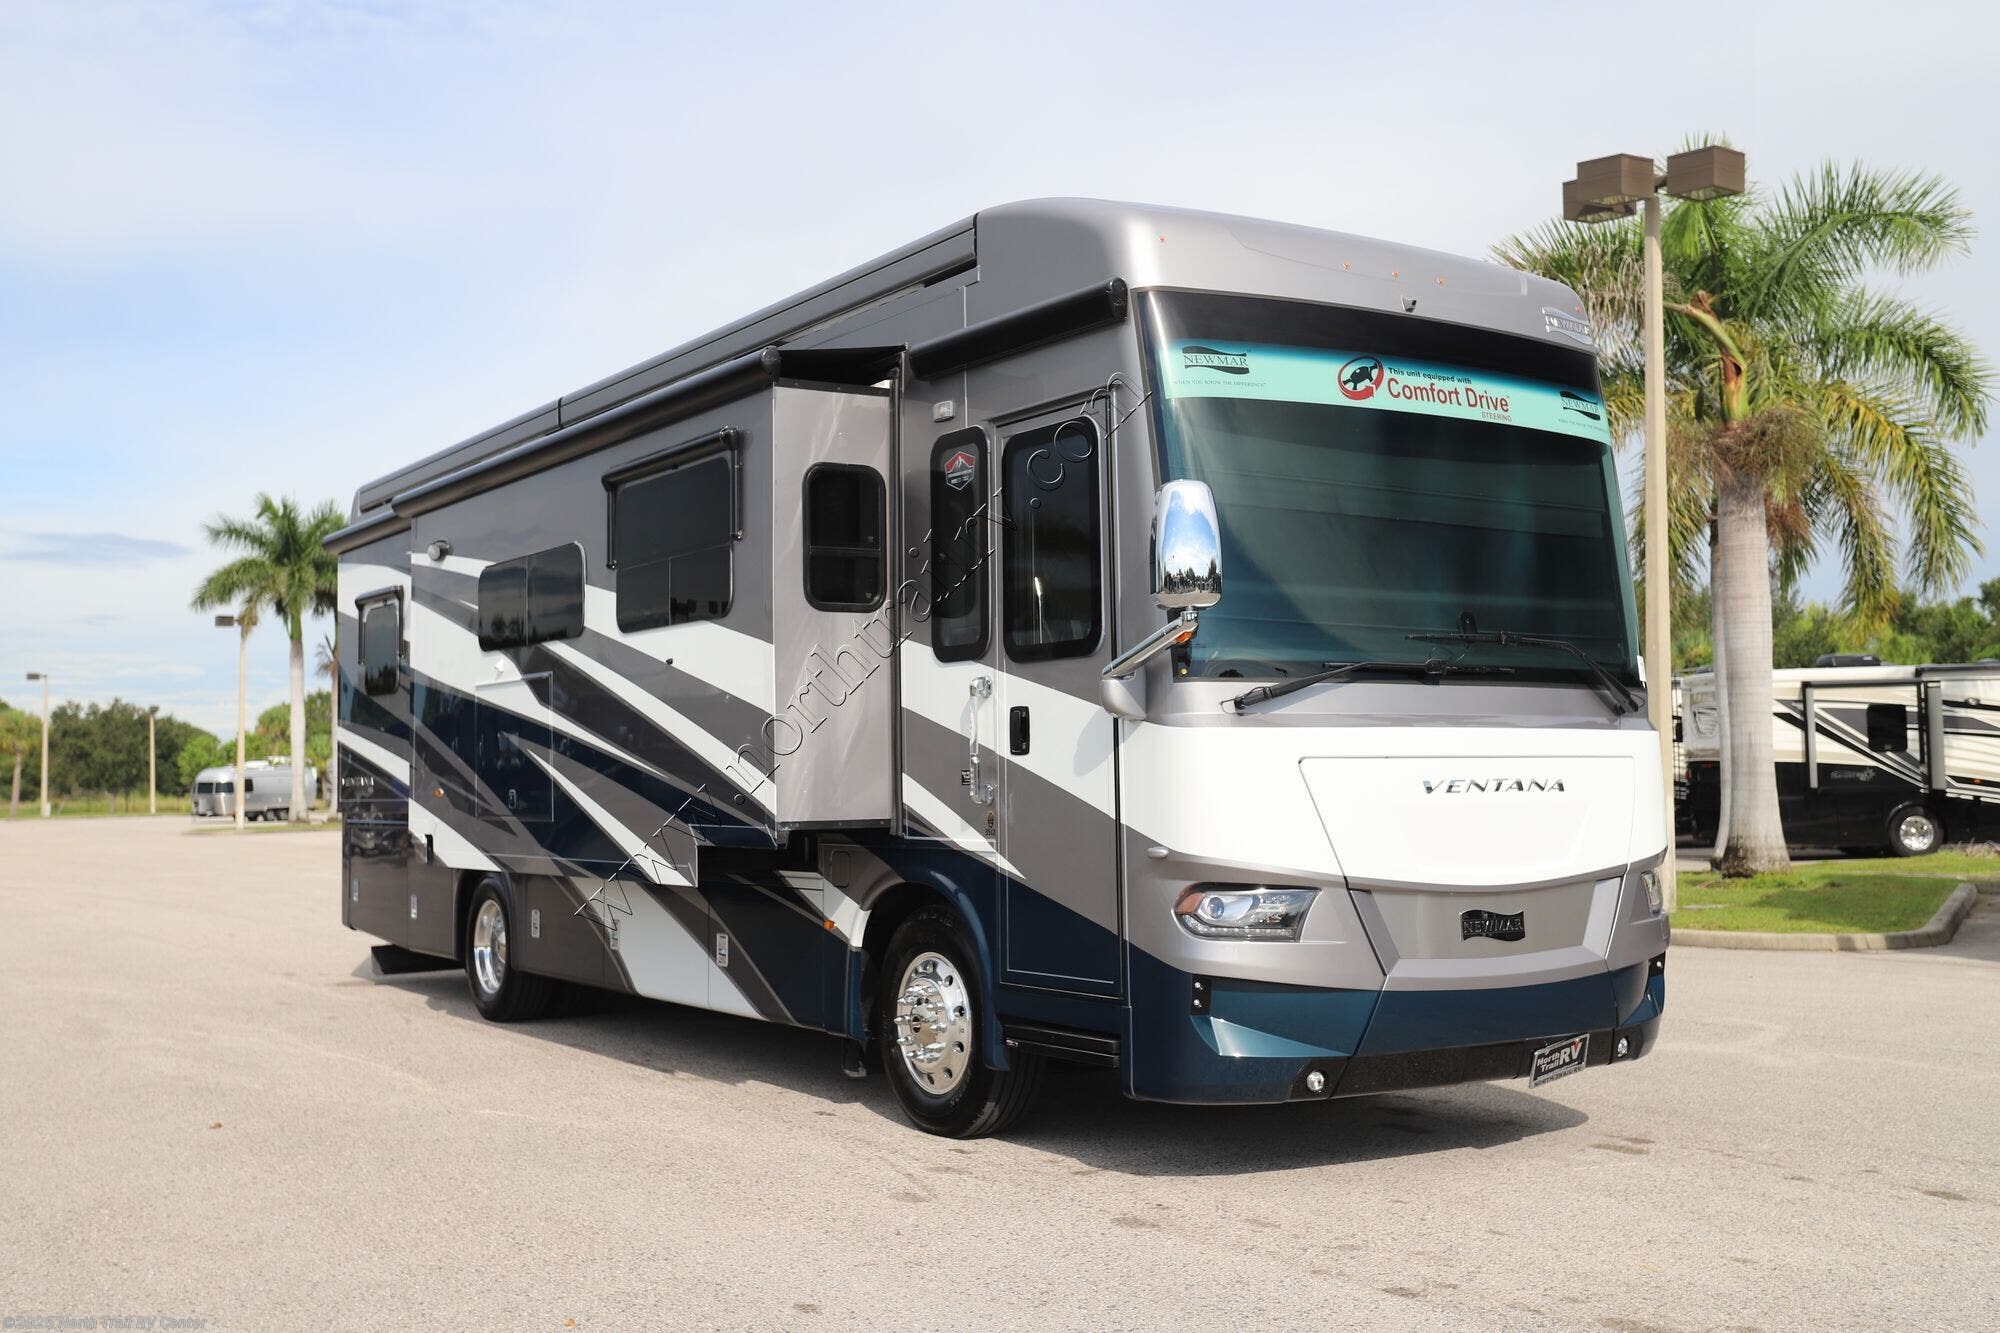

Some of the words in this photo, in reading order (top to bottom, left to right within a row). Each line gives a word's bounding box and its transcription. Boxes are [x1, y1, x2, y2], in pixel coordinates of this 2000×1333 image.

[1183, 354, 1248, 367] NEWMAR
[1388, 367, 1405, 376] This
[1406, 370, 1421, 378] unit
[1423, 372, 1455, 383] equipped
[1457, 377, 1472, 385] with
[1387, 378, 1462, 406] Comfort
[1465, 387, 1509, 412] Drive
[1482, 411, 1512, 422] STEERING
[1422, 778, 1565, 794] VENTANA
[1463, 919, 1524, 933] NEWMAR
[1537, 1052, 1560, 1067] North
[1559, 1041, 1583, 1065] RV
[1540, 1059, 1560, 1072] Trail
